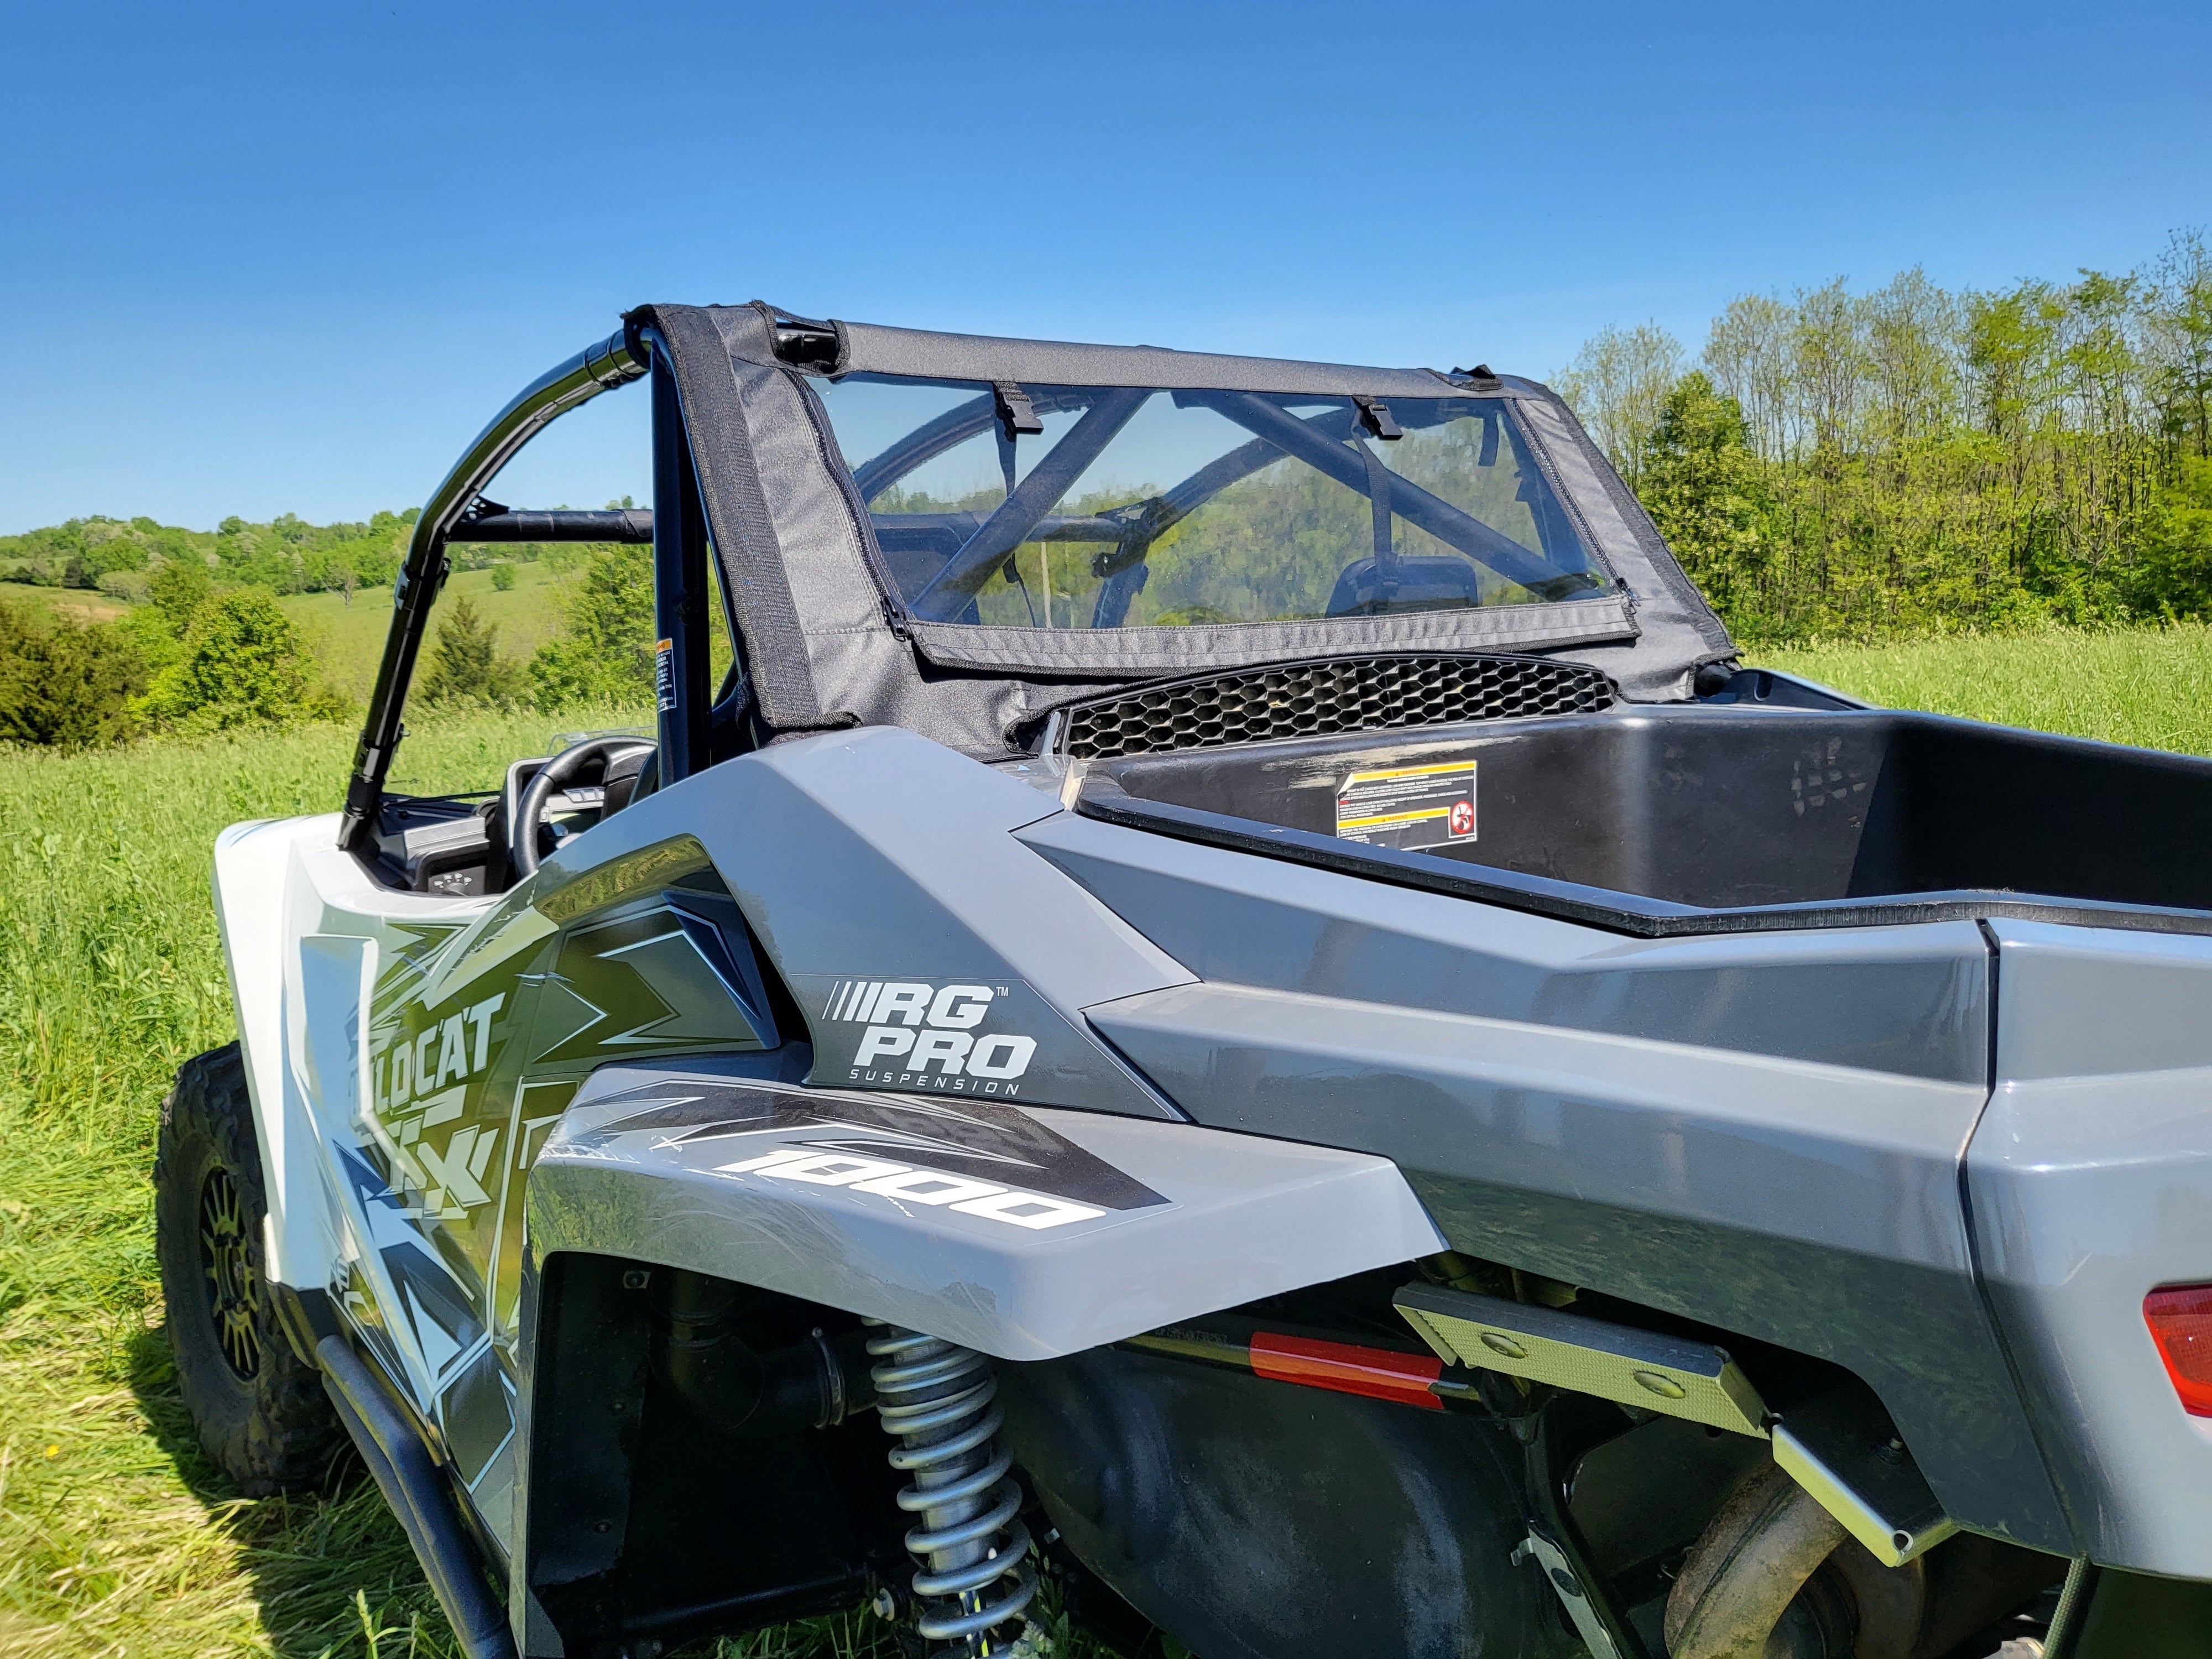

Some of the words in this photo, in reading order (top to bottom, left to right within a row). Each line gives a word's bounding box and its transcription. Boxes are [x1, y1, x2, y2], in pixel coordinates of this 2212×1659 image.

[853, 1025, 1038, 1080] PRO
[848, 1068, 1020, 1096] SUSPENSION
[711, 1150, 1107, 1230] 1000
